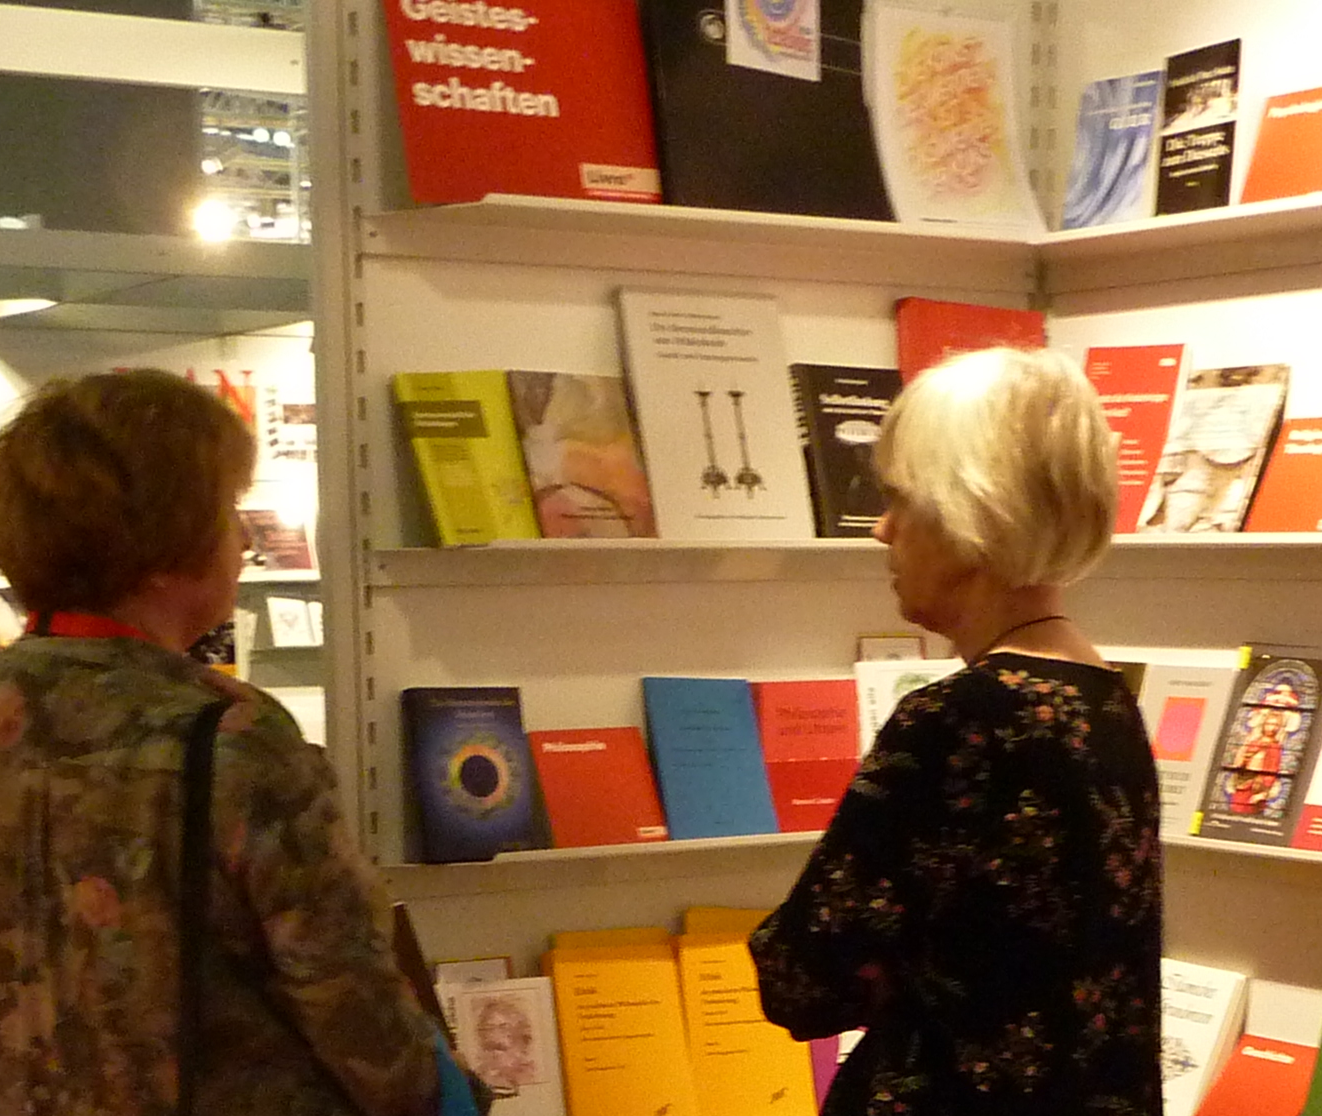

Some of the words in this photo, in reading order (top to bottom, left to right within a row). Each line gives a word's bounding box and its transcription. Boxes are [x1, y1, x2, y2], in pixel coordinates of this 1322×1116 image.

[400, 0, 539, 31] Geistes-
[405, 33, 535, 73] wissen-
[412, 76, 560, 117] schaften
